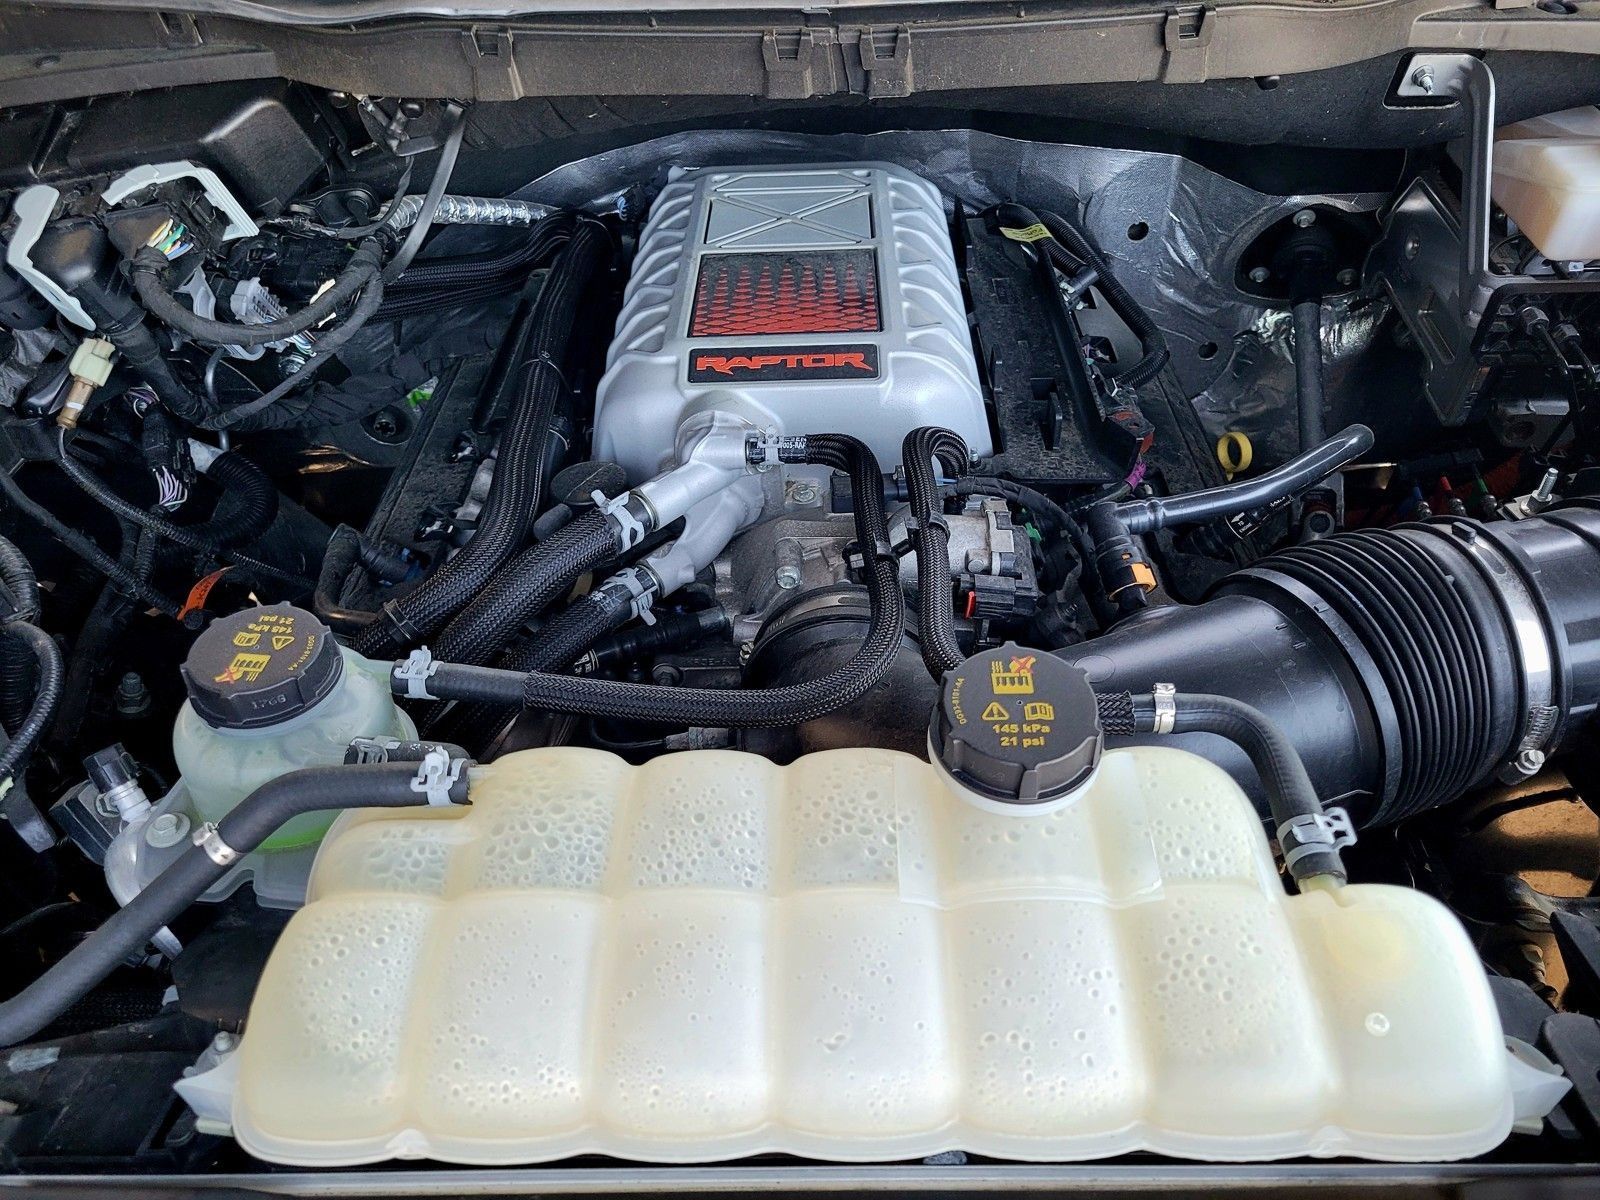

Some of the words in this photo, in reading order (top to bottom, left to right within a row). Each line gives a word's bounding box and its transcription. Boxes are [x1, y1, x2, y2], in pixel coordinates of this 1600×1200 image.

[696, 352, 873, 375] RAPTOR
[258, 614, 278, 623] psi
[279, 616, 295, 625] 21
[247, 623, 270, 632] kPa
[271, 626, 294, 634] 145
[992, 723, 1019, 734] 145
[1022, 723, 1051, 734] kPa
[999, 736, 1018, 747] 21
[1022, 736, 1045, 748] psi
